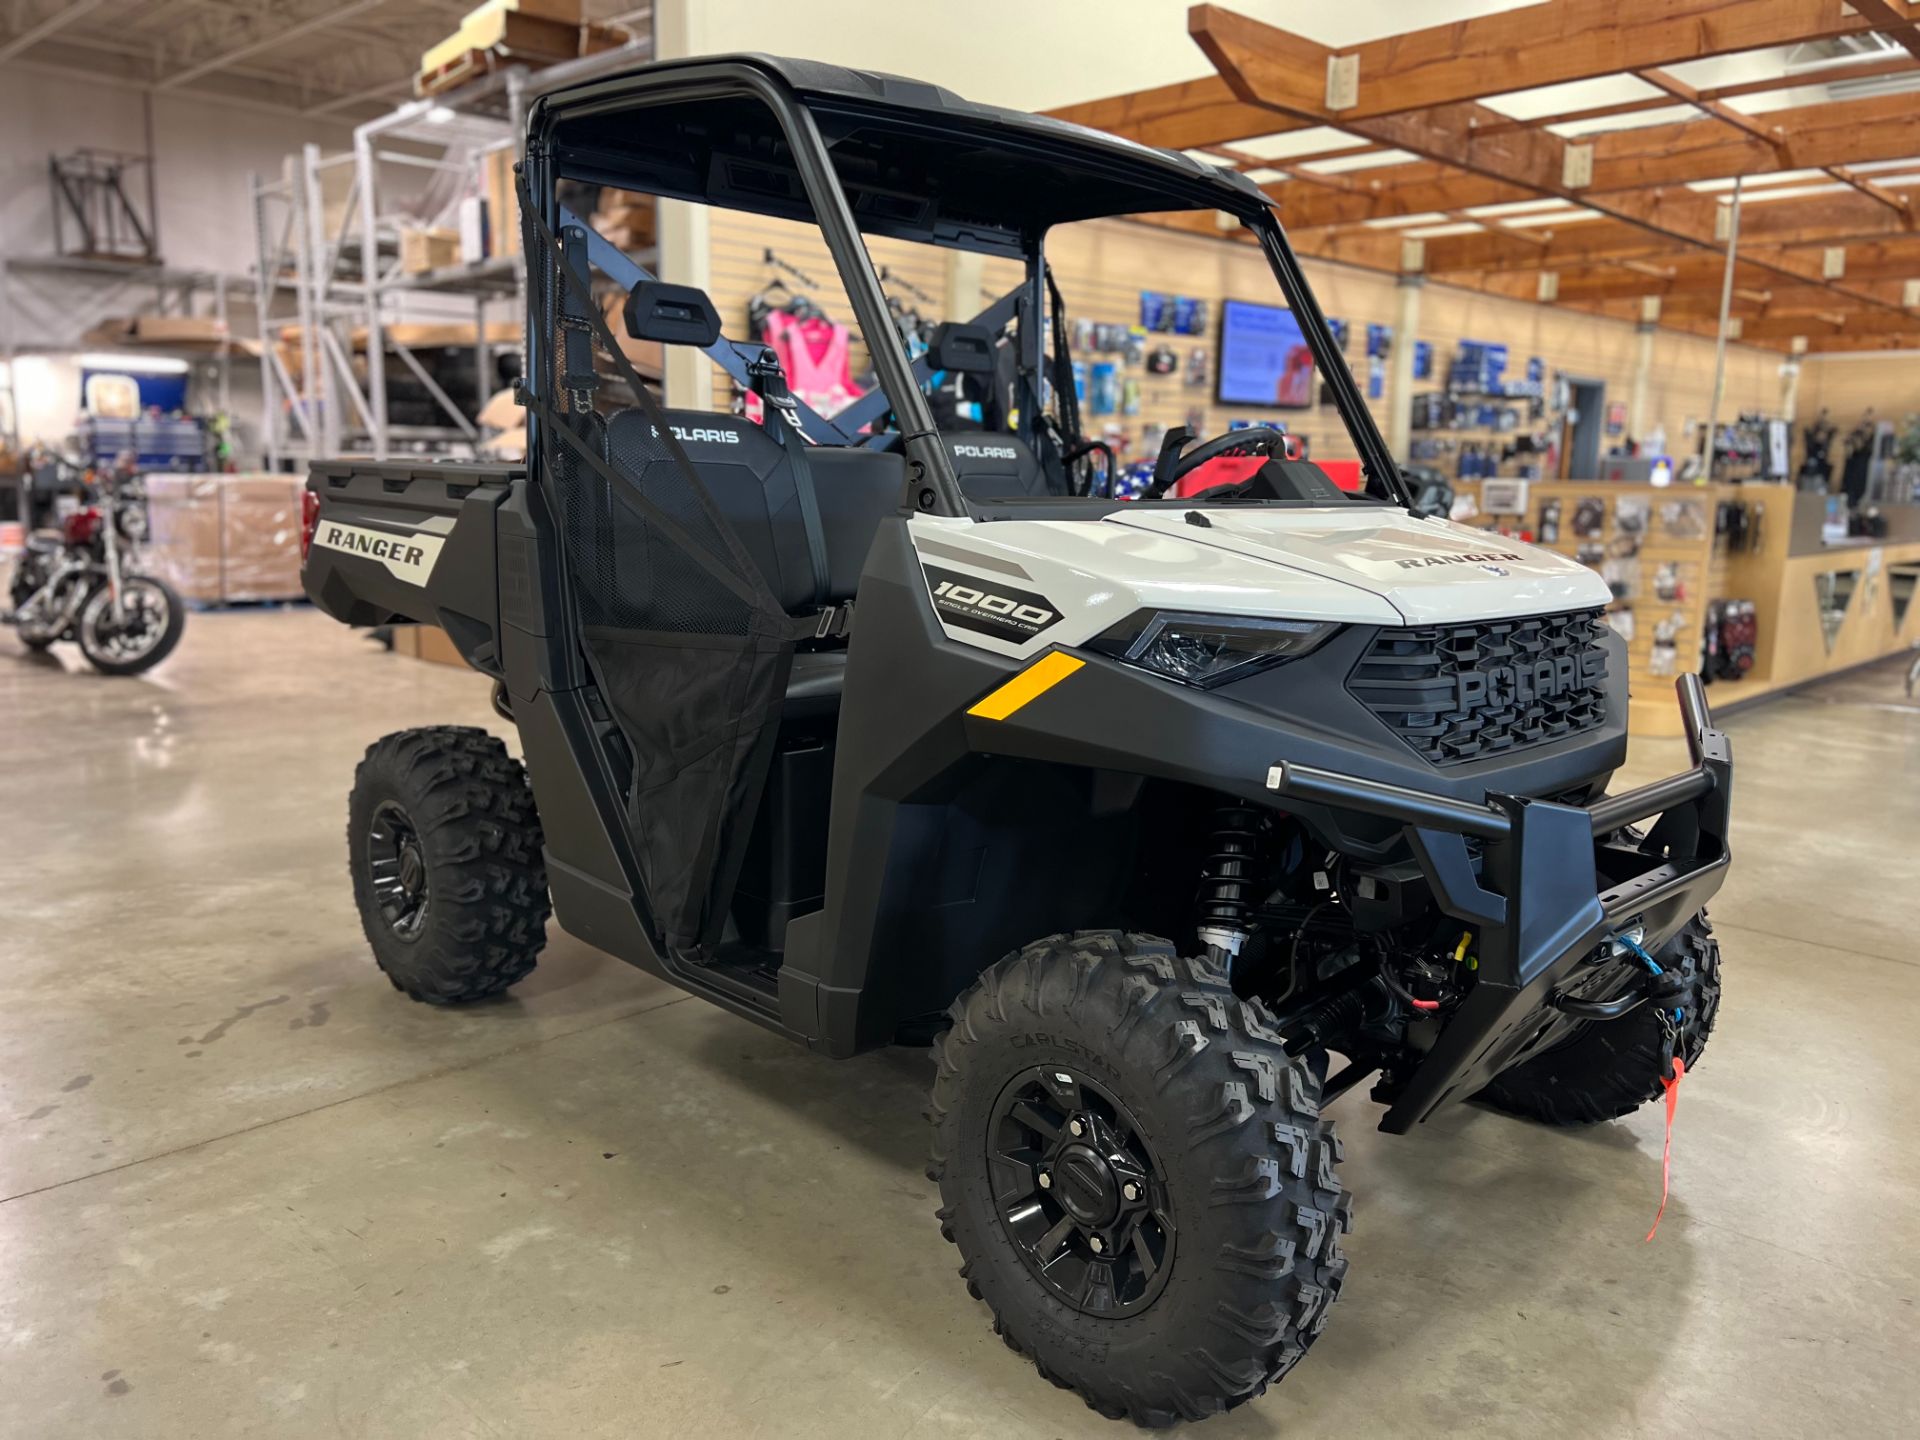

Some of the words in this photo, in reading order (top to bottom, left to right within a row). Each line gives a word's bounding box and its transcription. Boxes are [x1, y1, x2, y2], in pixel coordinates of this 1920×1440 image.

[953, 444, 1017, 459] POLARIS
[327, 528, 424, 566] RANGER
[1394, 553, 1525, 569] RANGER
[933, 581, 1053, 625] 1000
[938, 599, 970, 611] SINGLE
[970, 609, 1018, 626] OVERHEAD
[1017, 622, 1039, 632] CAM
[1457, 649, 1609, 712] POLARIS
